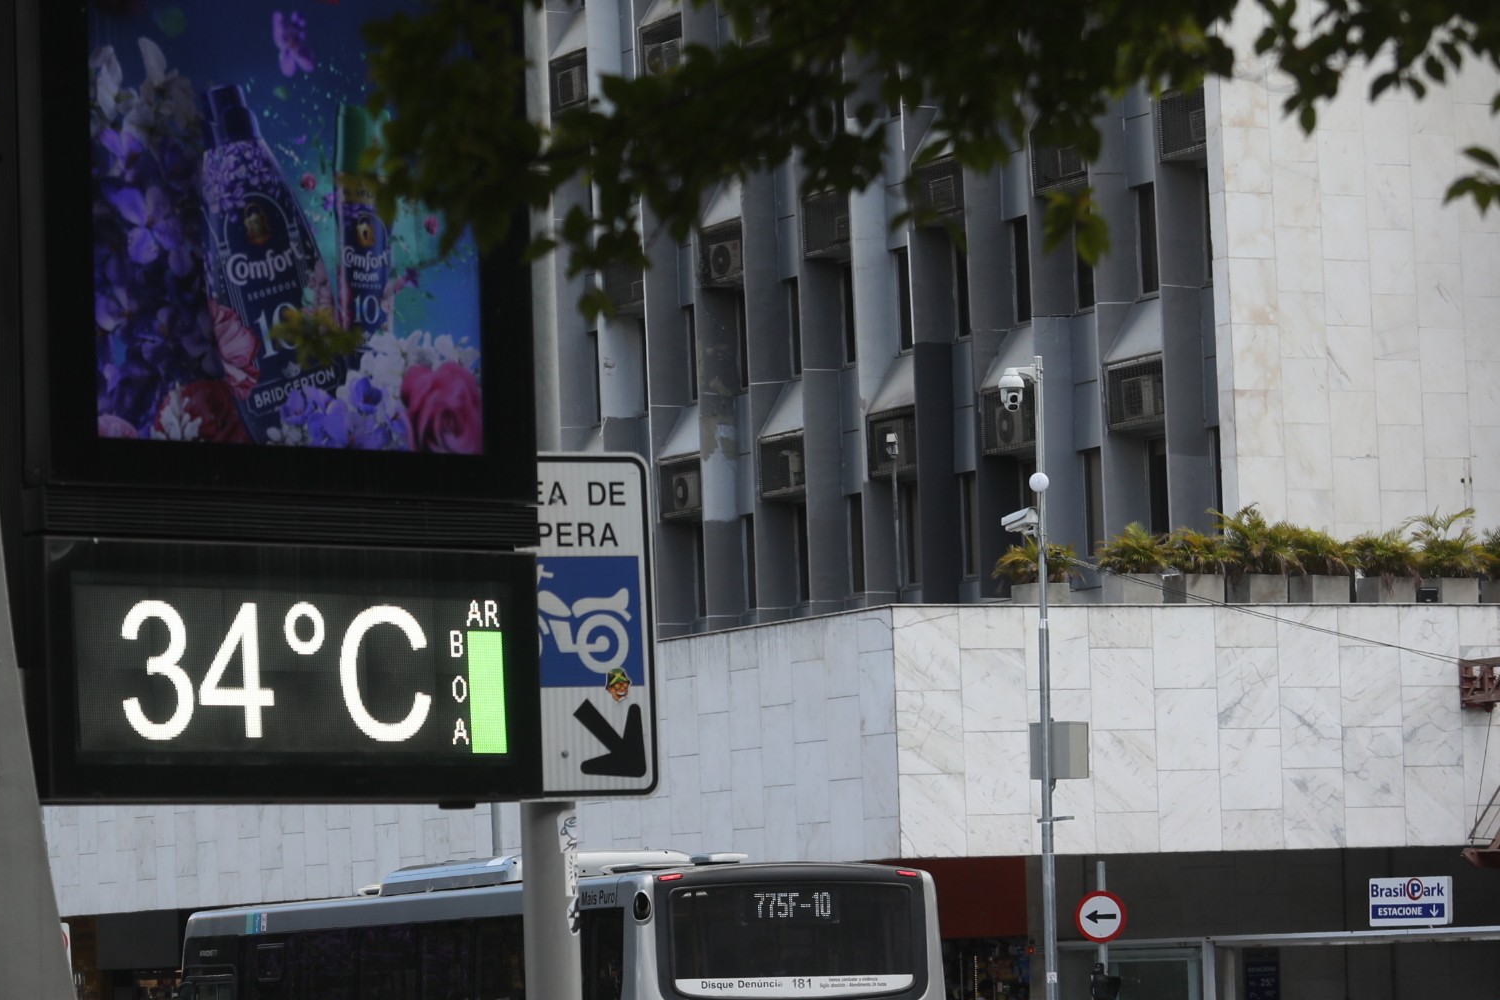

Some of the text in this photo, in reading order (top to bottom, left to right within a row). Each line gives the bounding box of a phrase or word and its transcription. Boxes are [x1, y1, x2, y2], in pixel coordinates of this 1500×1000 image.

[226, 242, 306, 286] Comfort
[342, 245, 389, 268] Comfort
[247, 281, 297, 301] SEGREDOS
[354, 295, 381, 325] 10
[253, 366, 336, 409] BRIDGERTON
[587, 481, 626, 506] DE
[538, 522, 619, 547] PERA
[466, 600, 500, 628] AR
[581, 889, 616, 906] Mais Puro
[754, 892, 831, 918] 775F-10
[1378, 906, 1423, 916] ESTACIONE
[701, 978, 812, 990] Disque Denúncia 181
